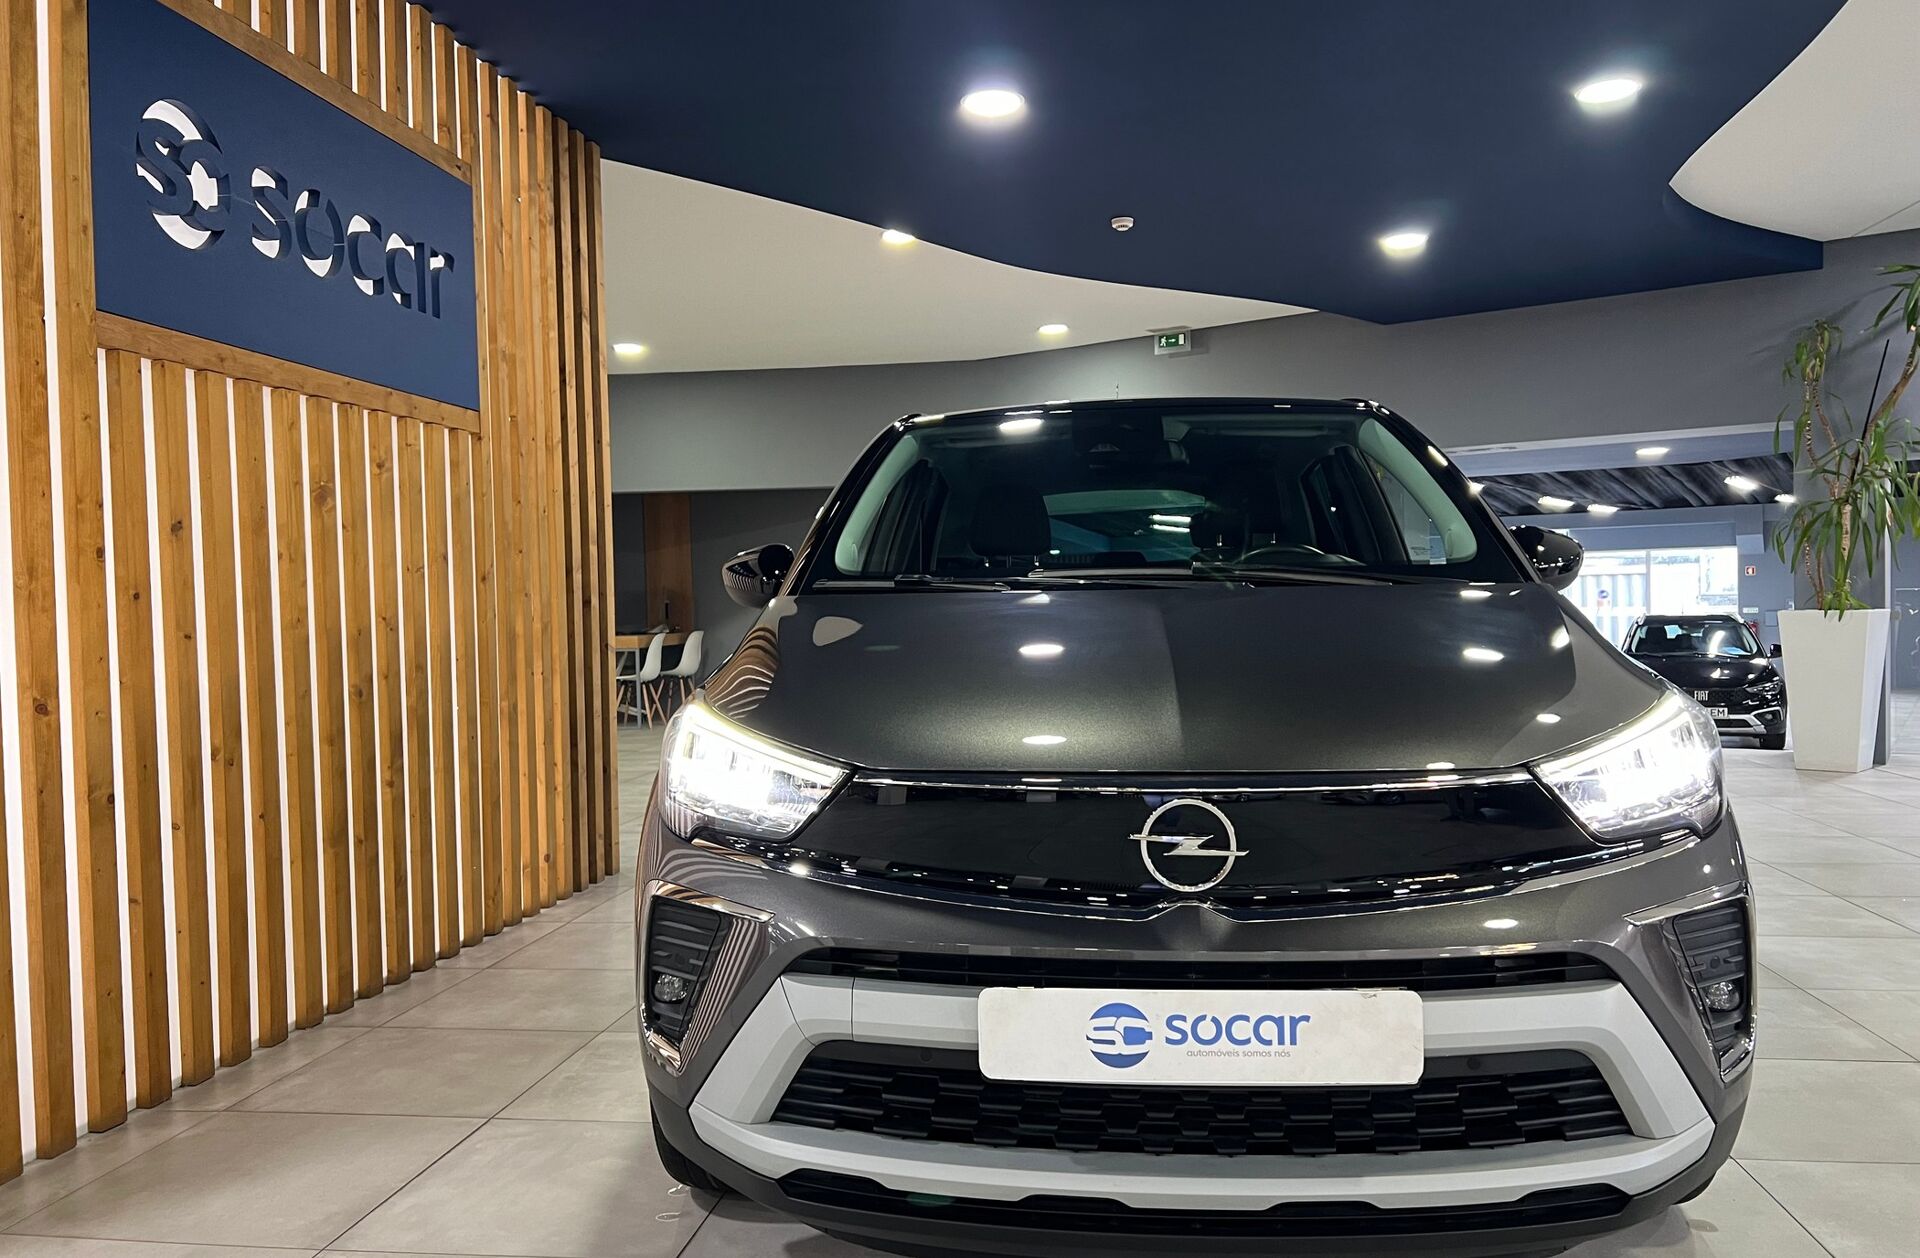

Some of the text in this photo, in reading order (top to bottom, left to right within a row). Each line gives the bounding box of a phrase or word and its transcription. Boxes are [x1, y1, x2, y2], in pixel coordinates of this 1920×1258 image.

[251, 165, 455, 319] socar
[1694, 690, 1709, 701] FIAT
[1707, 708, 1725, 717] EM
[1165, 1014, 1311, 1046] socar
[1186, 1049, 1291, 1058] automóveis somos nós
